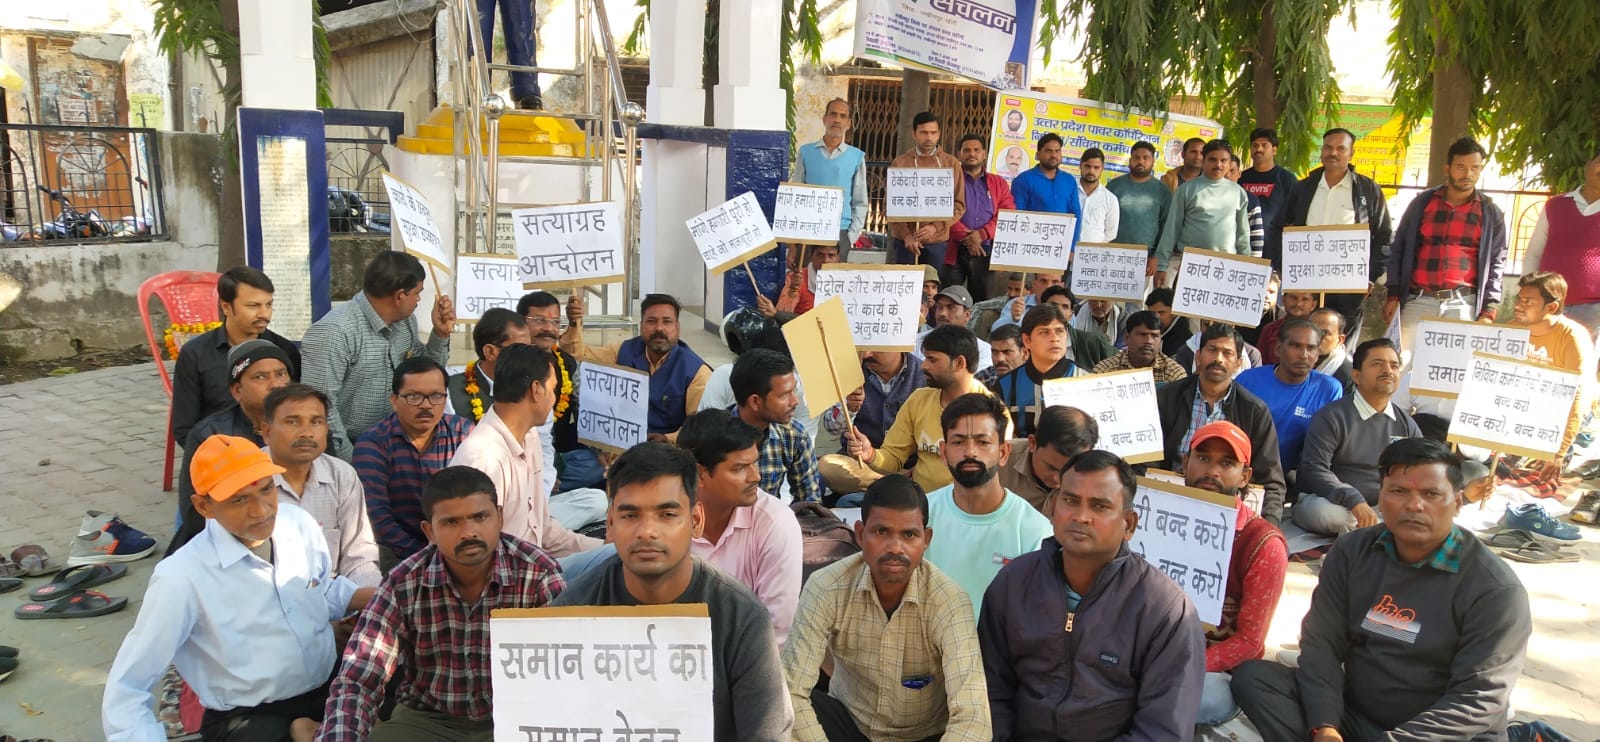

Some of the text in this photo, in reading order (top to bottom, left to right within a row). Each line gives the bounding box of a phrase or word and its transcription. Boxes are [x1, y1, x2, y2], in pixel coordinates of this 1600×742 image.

[518, 209, 606, 235] सत्याग्रह
[997, 214, 1067, 240] कार्य के अनुरूप
[994, 241, 1063, 259] सुरक्षा उपकरण दो
[1287, 233, 1367, 258] कार्य के अनुरूप
[520, 244, 615, 276] आन्दोलन
[1288, 257, 1367, 283] सुरक्षा उपकरण दो
[816, 274, 914, 297] पेट्रोल और मोबाईल
[1187, 258, 1266, 291] कार्य के अनुरूप
[861, 298, 885, 317] कार्य
[888, 299, 899, 316] के
[1182, 287, 1262, 313] सुरक्षा उपकरण दो
[854, 317, 903, 340] अनुबंध हो
[1424, 330, 1527, 357] समान कार्य का
[585, 368, 640, 403] सत्याग्रह
[1116, 384, 1129, 399] का
[580, 407, 641, 445] आन्दोलन
[1100, 406, 1117, 423] करो
[1460, 411, 1482, 428] बन्द
[1514, 423, 1536, 438] बन्द
[1537, 425, 1560, 443] करो
[1111, 432, 1133, 446] बन्द
[1135, 424, 1158, 442] करो
[1156, 509, 1190, 542] बन्द
[1193, 512, 1228, 551] करो
[1192, 561, 1223, 601] करो
[499, 623, 708, 682] समान कार्य का
